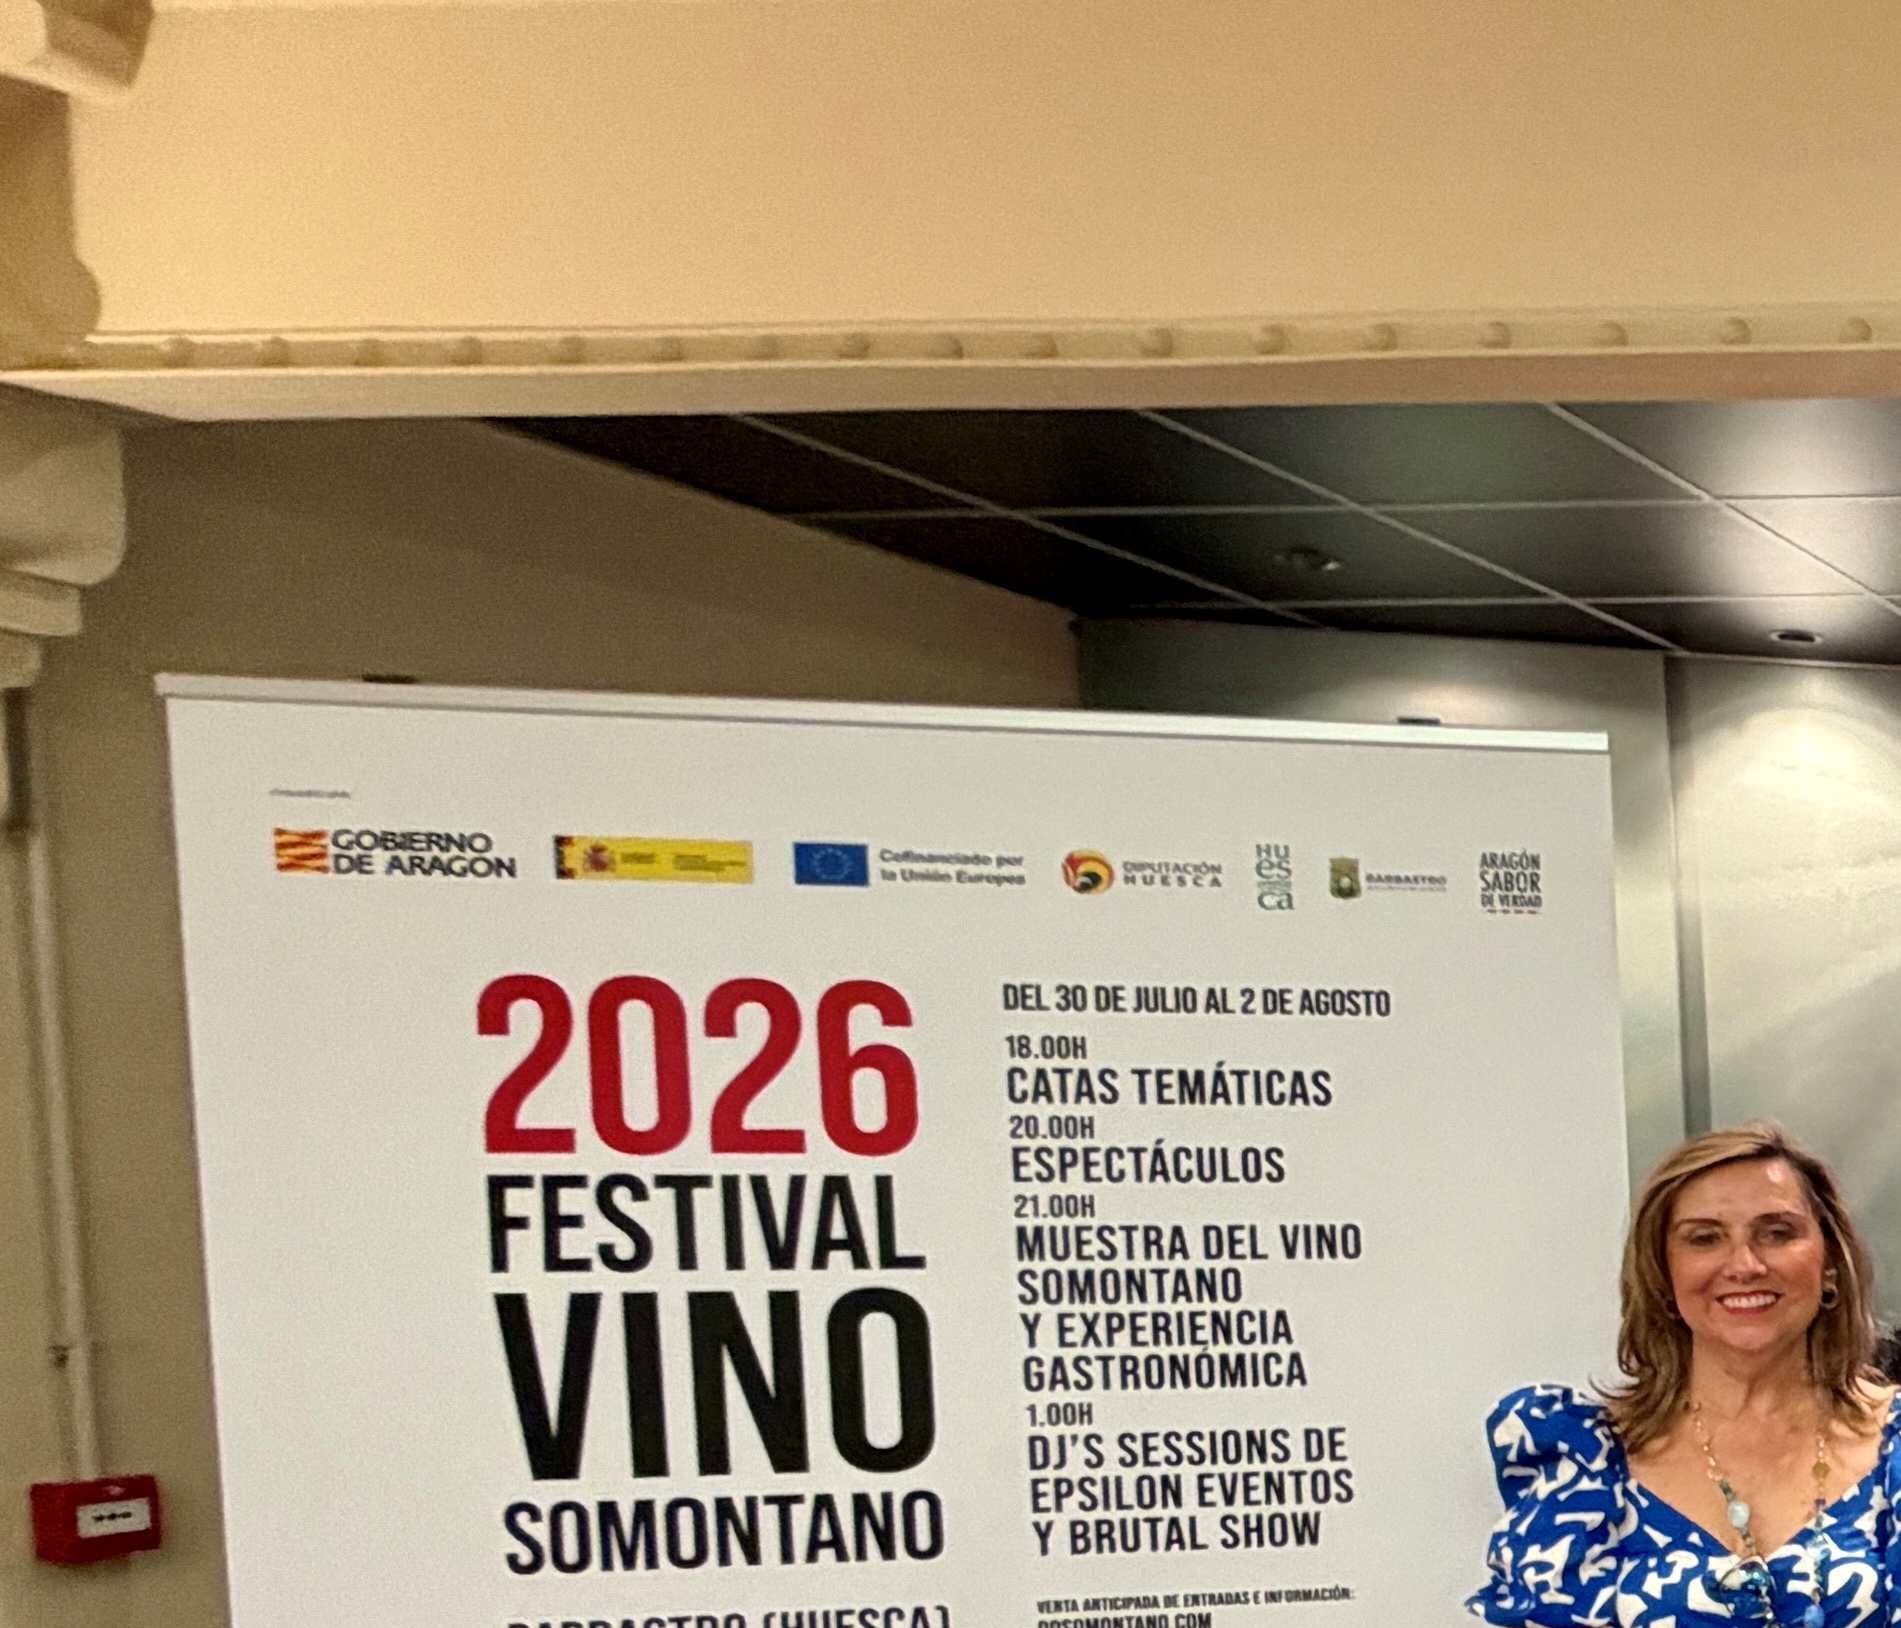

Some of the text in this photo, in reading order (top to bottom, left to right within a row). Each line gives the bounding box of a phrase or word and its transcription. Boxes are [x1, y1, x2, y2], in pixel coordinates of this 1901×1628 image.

[331, 829, 492, 853] GOBIERNO
[332, 854, 517, 878] DE ARAGON
[879, 848, 1024, 868] Cofinanciado por
[1123, 861, 1222, 874] DIPUTACIÓN
[1480, 849, 1541, 870] ARAGÓN
[881, 869, 896, 882] la
[901, 868, 952, 884] Unión
[1123, 874, 1222, 888] HUESCA
[1480, 872, 1541, 893] SABOR
[1481, 893, 1542, 908] DE VERDAD
[1003, 983, 1391, 1017] DEL 30 DE JULIO AL 2 DE AGOSTO
[1006, 1035, 1087, 1059] 18.00H
[477, 973, 918, 1156] 2026
[1007, 1061, 1332, 1107] CATAS TEMÁTICAS
[1010, 1115, 1095, 1140] 20.00H
[1012, 1139, 1285, 1184] ESPECTÁCULOS
[1014, 1194, 1096, 1219] 21.00H
[486, 1173, 927, 1273] FESTIVAL
[1016, 1224, 1362, 1262] MUESTRA DEL VINO
[1017, 1267, 1242, 1305] SOMONTANO
[1021, 1309, 1293, 1349] Y EXPERIENCIA
[1023, 1346, 1307, 1392] GASTRONÓMICA
[493, 1287, 936, 1481] VINO
[1026, 1402, 1093, 1427] 1.00H
[1117, 1428, 1291, 1468] SESSIONS
[1304, 1427, 1348, 1462] DE
[1030, 1468, 1354, 1514] EPSILON EVENTOS
[503, 1489, 946, 1575] SOMONTANO
[1033, 1511, 1321, 1556] Y BRUTAL SHOW
[1037, 1598, 1078, 1614] VENTA
[1083, 1595, 1159, 1612] ANTICIPADA
[1164, 1594, 1180, 1608] DE
[1184, 1591, 1250, 1608] ENTRADAS
[1254, 1591, 1260, 1604] E
